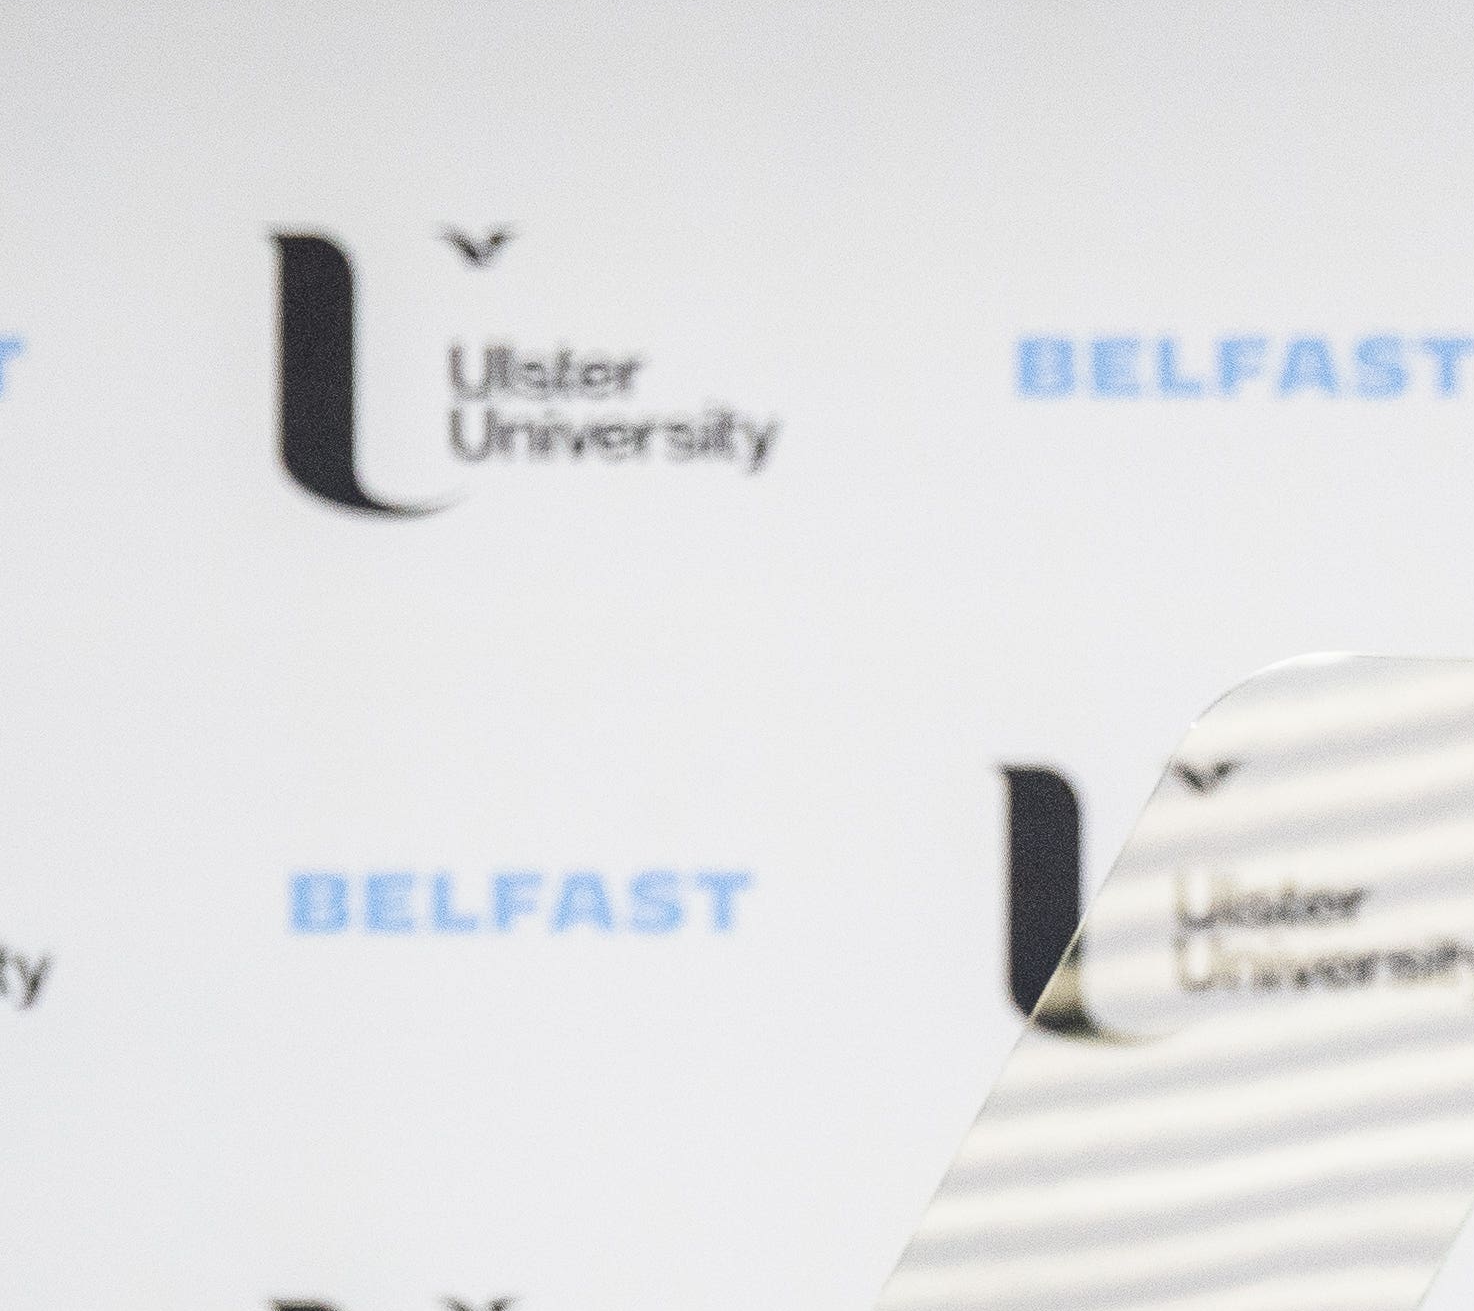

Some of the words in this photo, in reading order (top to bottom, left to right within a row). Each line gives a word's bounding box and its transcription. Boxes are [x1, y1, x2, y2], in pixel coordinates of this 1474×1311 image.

[446, 341, 642, 400] Ulster
[446, 405, 777, 470] University
[286, 868, 752, 936] BELFAST
